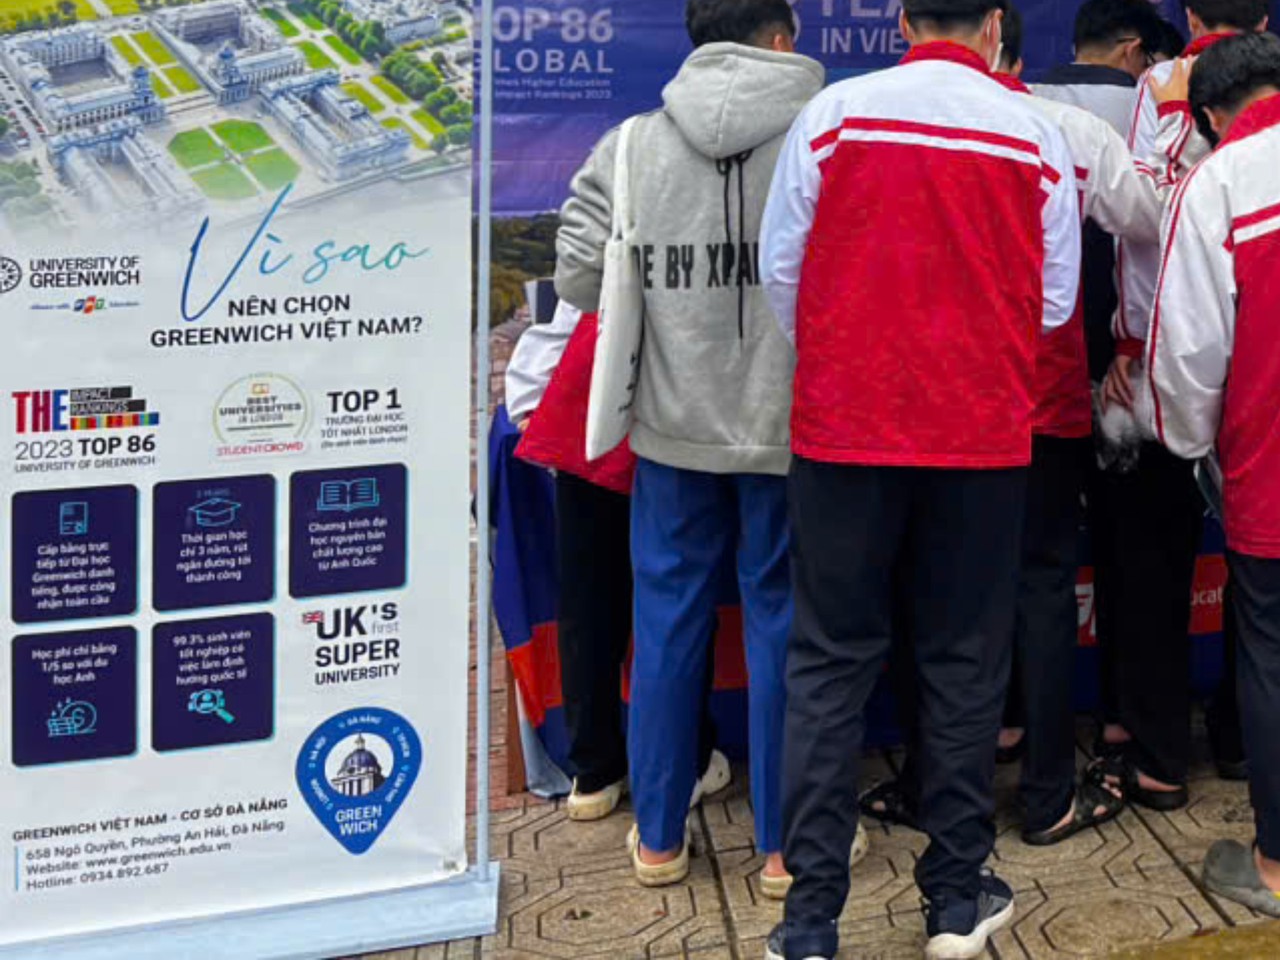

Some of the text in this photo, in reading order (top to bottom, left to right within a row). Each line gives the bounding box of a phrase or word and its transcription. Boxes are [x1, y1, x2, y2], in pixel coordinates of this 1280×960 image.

[560, 7, 613, 43] 86
[821, 27, 851, 54] IN
[29, 255, 140, 272] UNIVERSITY OF
[302, 240, 430, 284] sao
[665, 244, 694, 289] BY
[29, 270, 140, 288] GREENWICH
[228, 294, 351, 318] NÊN CHỌN
[150, 316, 424, 348] GREENWICH VIỆT NAM?
[326, 387, 402, 414] TOP 1
[11, 388, 69, 434] THE
[219, 403, 302, 416] UNIVERSITIES
[325, 412, 364, 426] TRƯỜNG
[384, 412, 405, 423] HỌC
[340, 424, 366, 437] NHẤT
[369, 423, 408, 435] LONDON
[15, 433, 157, 461] 2023 TOP 86
[15, 455, 156, 474] UNIVERSITY OF GREENWICH
[308, 521, 346, 533] Chương
[205, 531, 228, 544] gian
[228, 529, 248, 542] học
[37, 541, 87, 557] Cấp bằng
[198, 545, 205, 556] 3
[364, 543, 384, 554] cao
[91, 554, 111, 566] học
[331, 557, 350, 569] Anh
[31, 567, 115, 583] Greenwich danh
[216, 570, 242, 582] công
[90, 581, 116, 594] công
[371, 620, 400, 636] first
[206, 632, 228, 644] sinh
[314, 638, 401, 668] SUPER
[42, 657, 109, 672] 1/5 so du
[53, 671, 96, 685] học Anh
[314, 662, 401, 686] UNIVERSITY
[12, 797, 289, 842] GREENWICH VIỆT NAM CƠ SỞ ĐÀ NẴNG
[335, 804, 383, 824] GREEN
[339, 820, 378, 837] WICH
[25, 819, 286, 861] 658 Ngô Quyền, Phường An Đà Nẵng
[26, 841, 233, 876] Website: www.greenwich.edu.vn
[26, 863, 170, 891] Hotline: 0934.892.687
